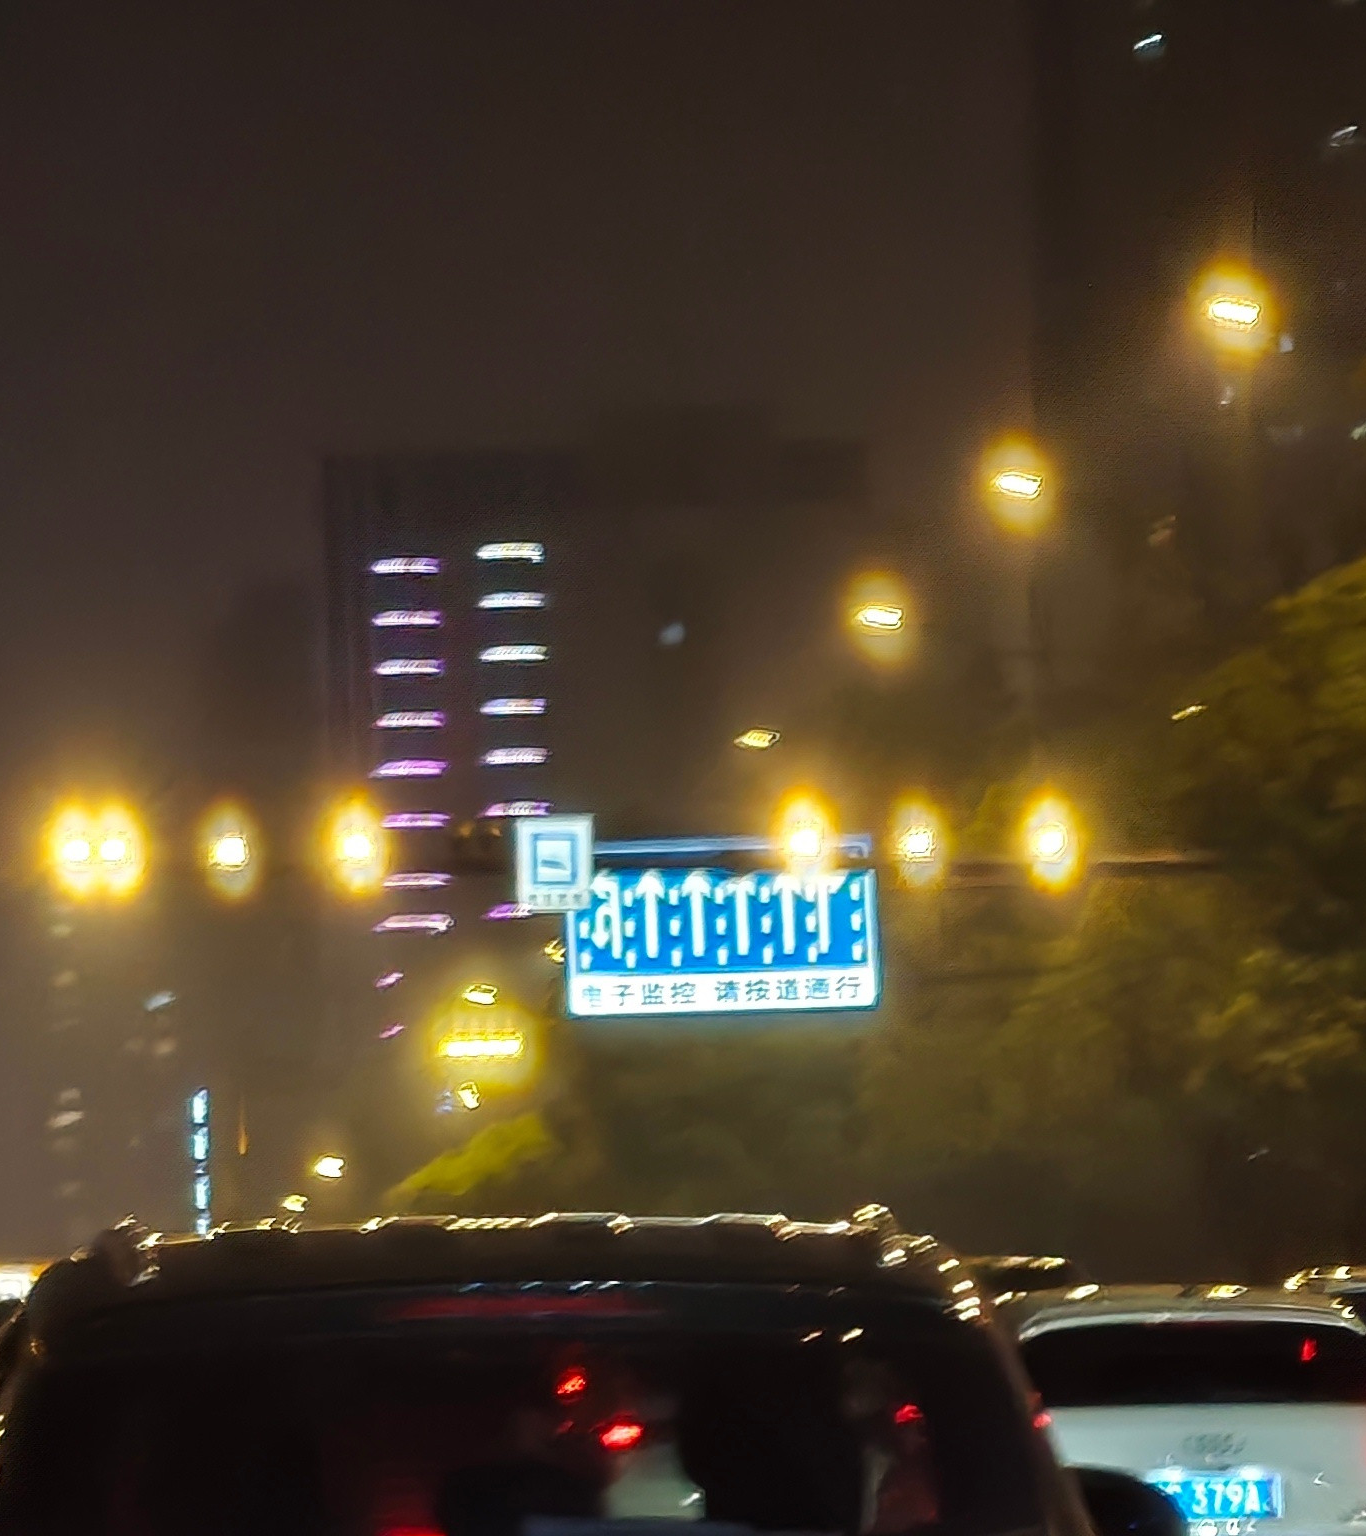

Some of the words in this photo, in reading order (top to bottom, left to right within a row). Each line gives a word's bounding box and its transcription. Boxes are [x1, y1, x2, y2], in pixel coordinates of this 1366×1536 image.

[582, 982, 697, 1007] 电子监控
[714, 976, 861, 1003] 请按道通行
